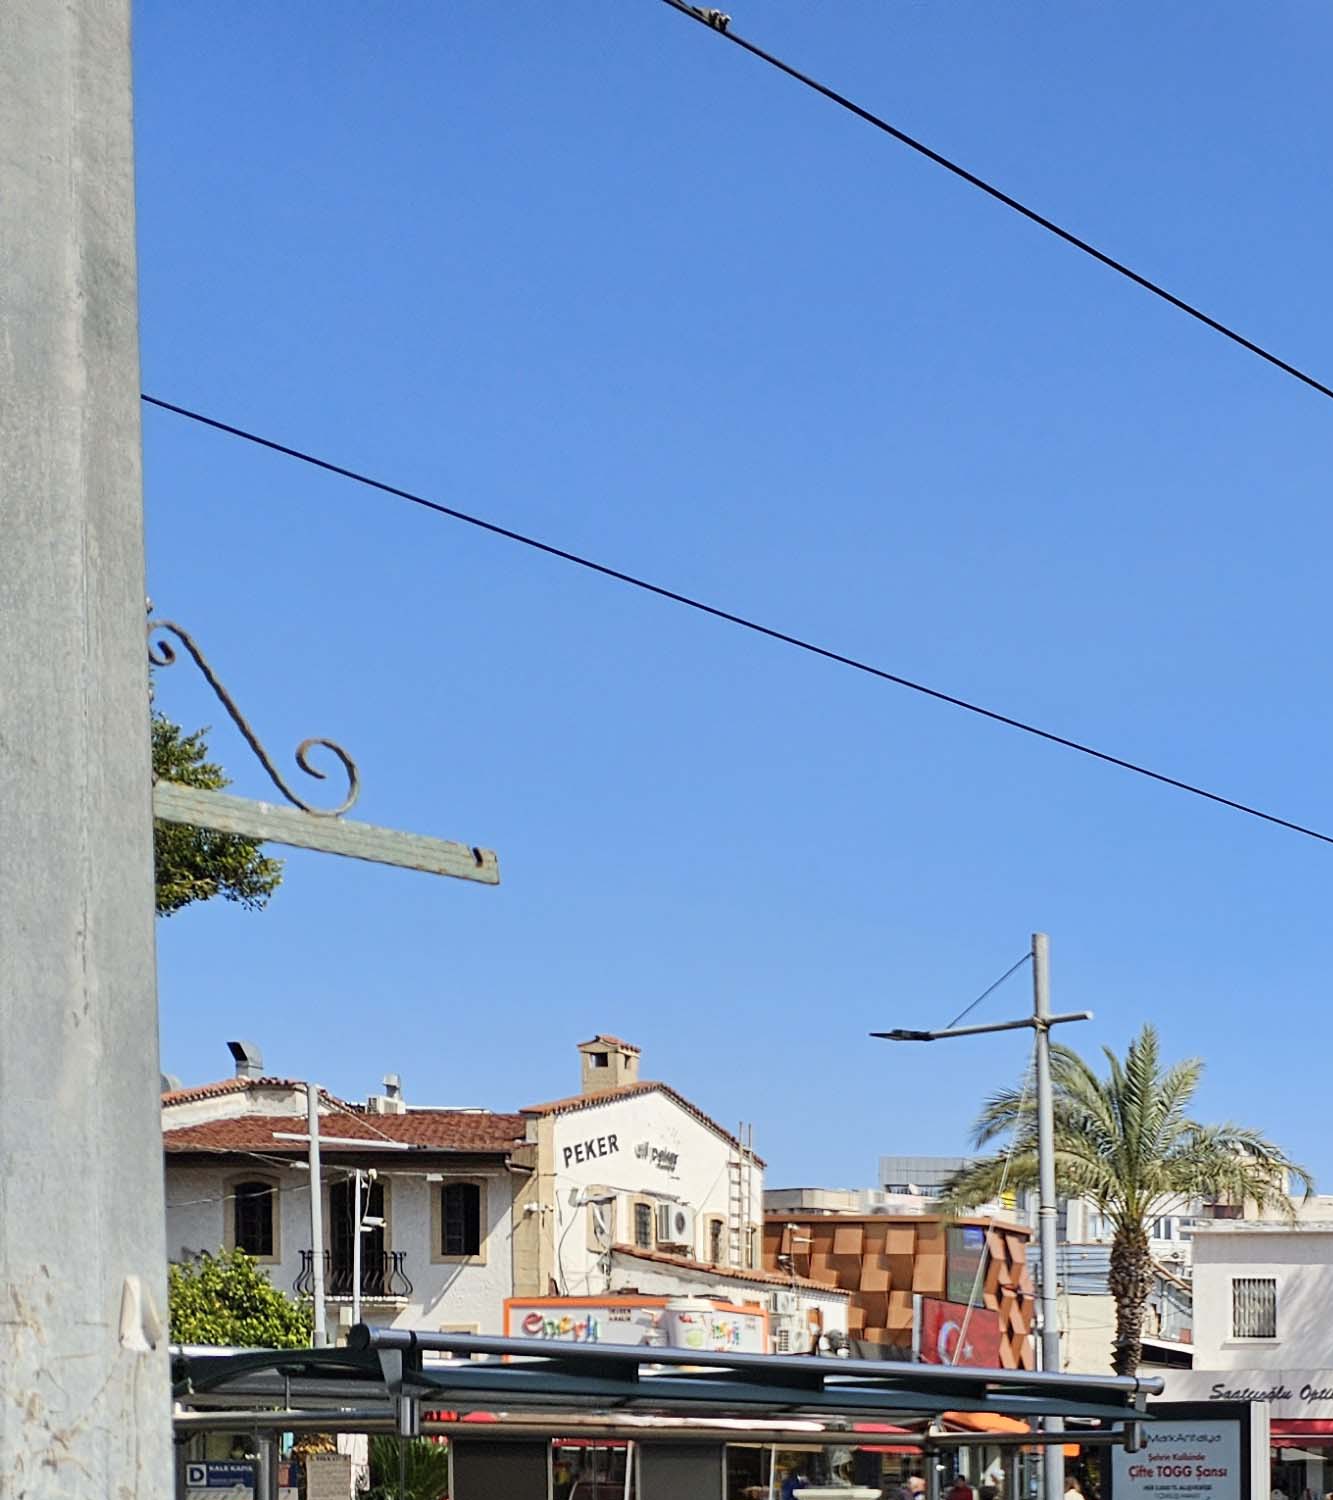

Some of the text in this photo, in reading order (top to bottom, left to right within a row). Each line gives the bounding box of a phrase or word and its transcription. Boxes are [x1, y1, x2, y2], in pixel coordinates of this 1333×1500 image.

[562, 1133, 620, 1169] PEKER
[1128, 1465, 1154, 1481] Çifte
[1156, 1465, 1193, 1477] TOGG
